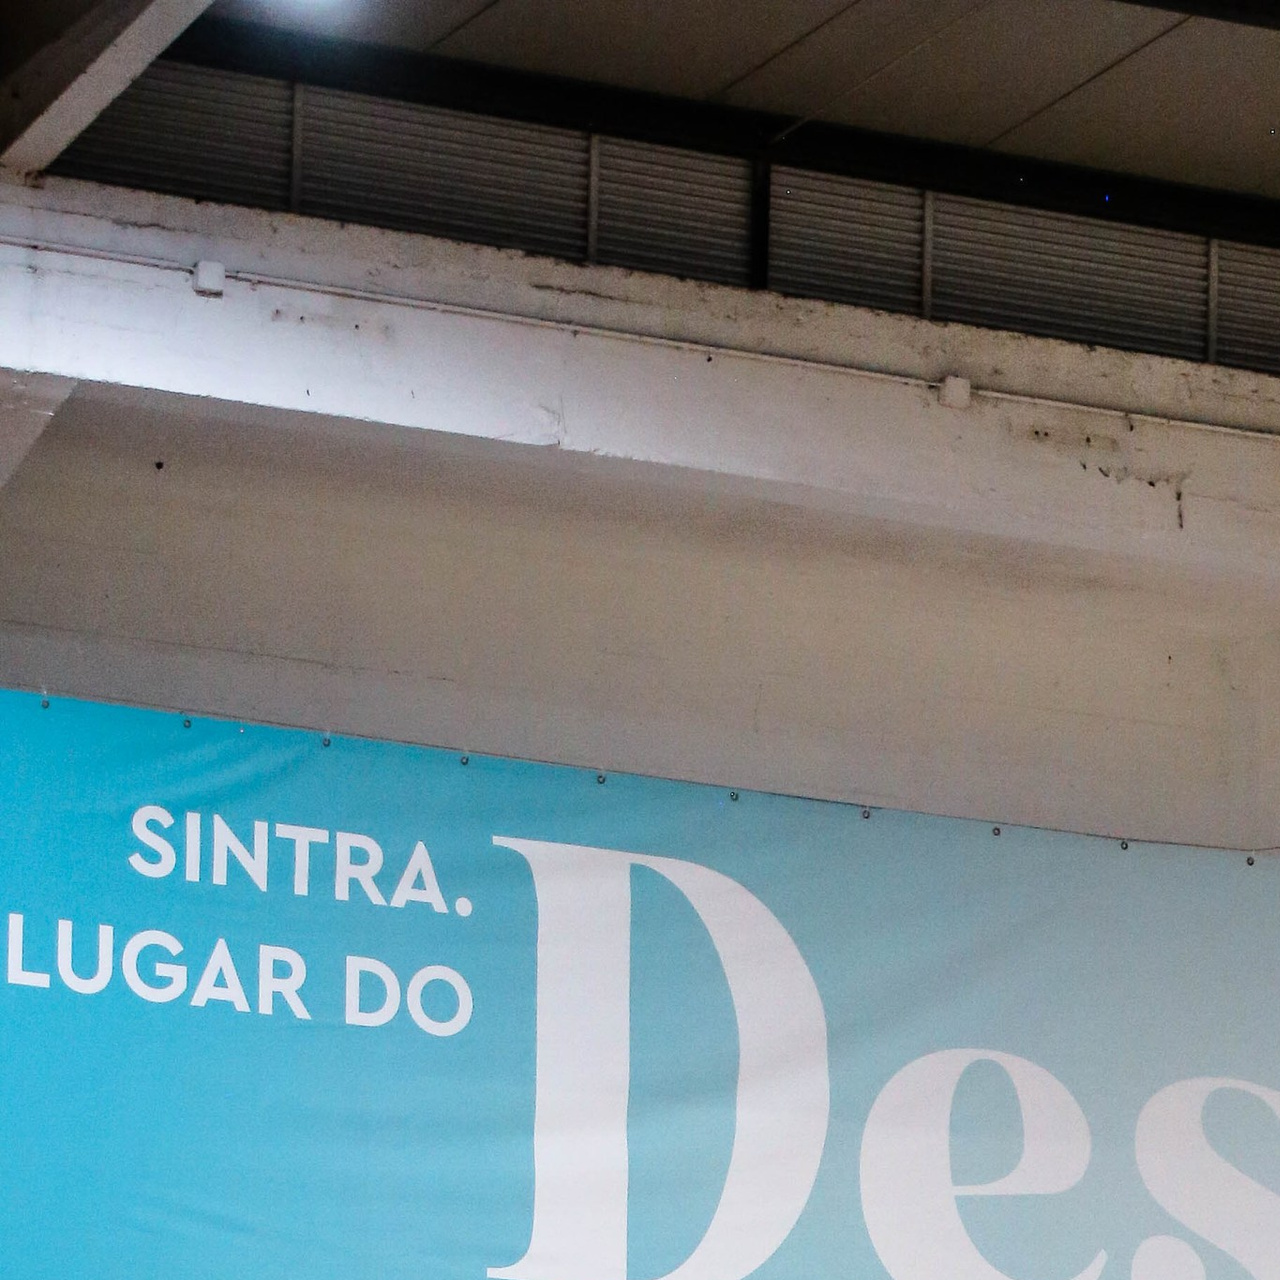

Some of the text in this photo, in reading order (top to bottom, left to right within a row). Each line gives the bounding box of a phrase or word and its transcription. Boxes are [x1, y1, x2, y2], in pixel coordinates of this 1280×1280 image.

[129, 805, 474, 917] SINTRA.
[6, 913, 474, 1037] LUGAR DO
